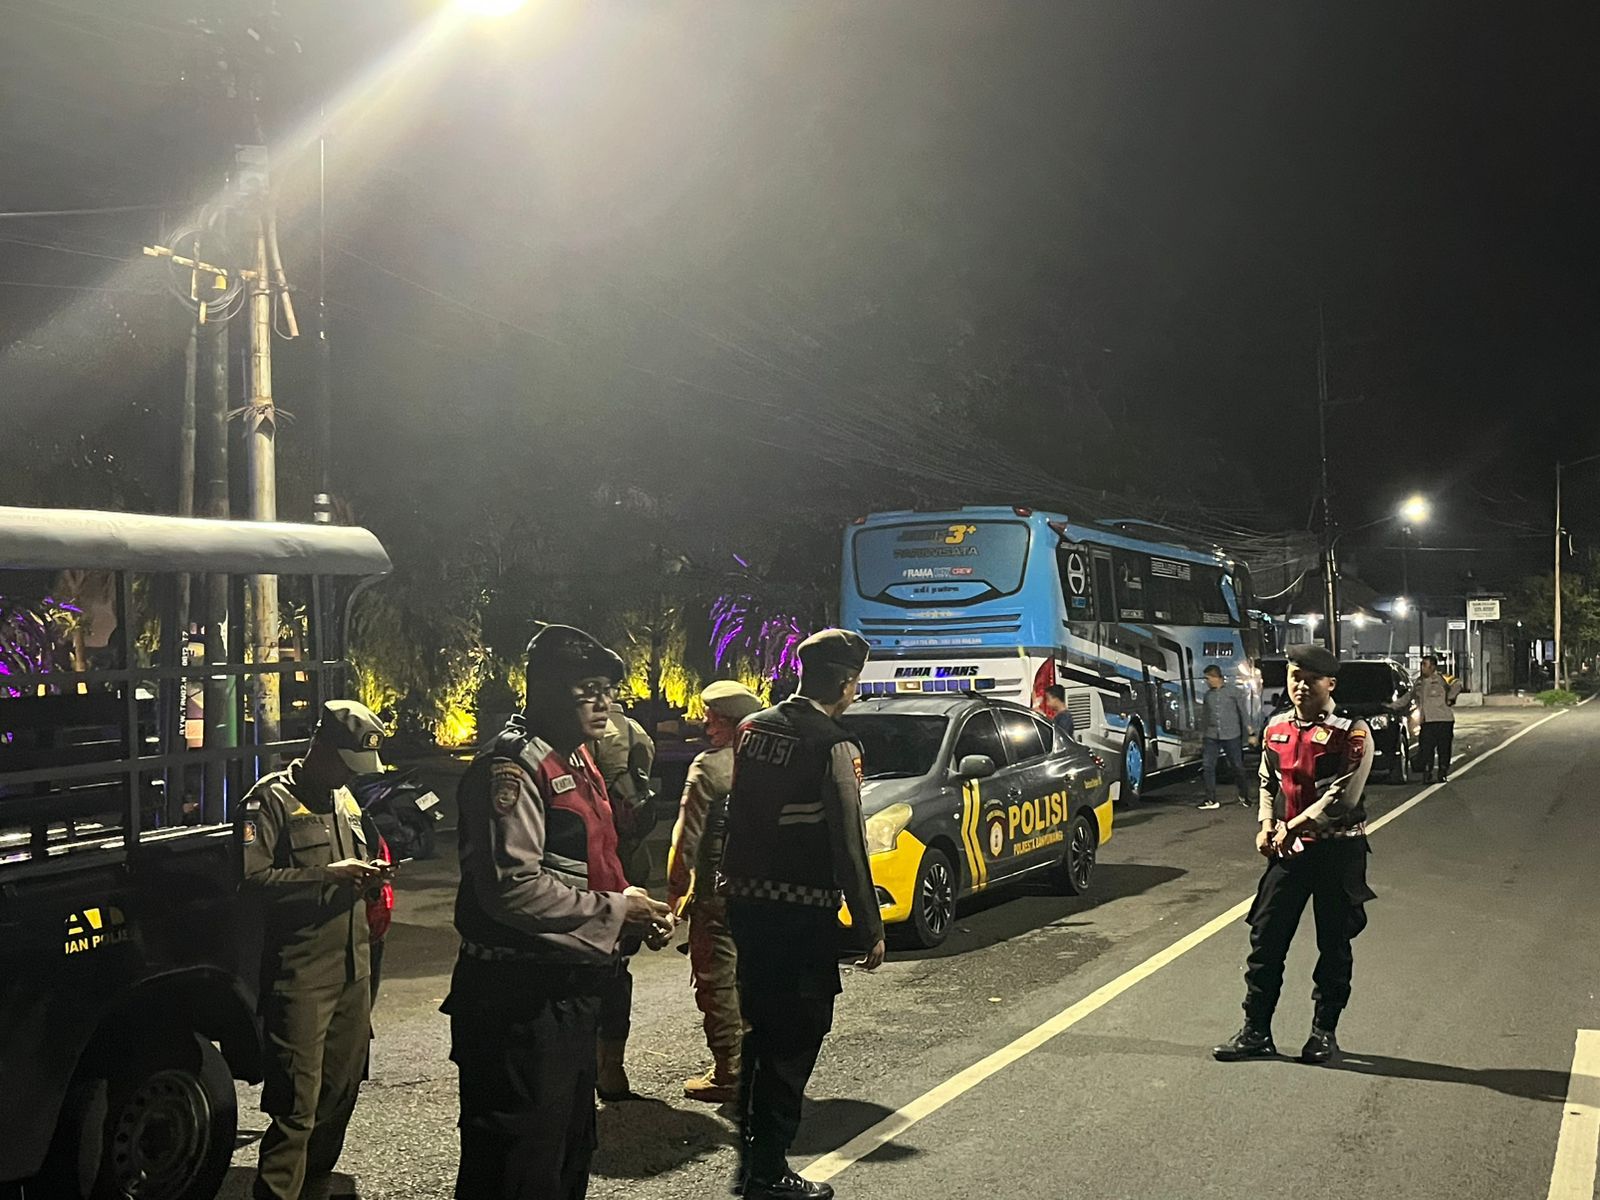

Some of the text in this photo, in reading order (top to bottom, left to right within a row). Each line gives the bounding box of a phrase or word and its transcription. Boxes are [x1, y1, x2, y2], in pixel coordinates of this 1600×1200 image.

[894, 665, 980, 678] RAMA TRANS
[737, 730, 795, 768] POLISI
[1007, 790, 1068, 840] POLISI
